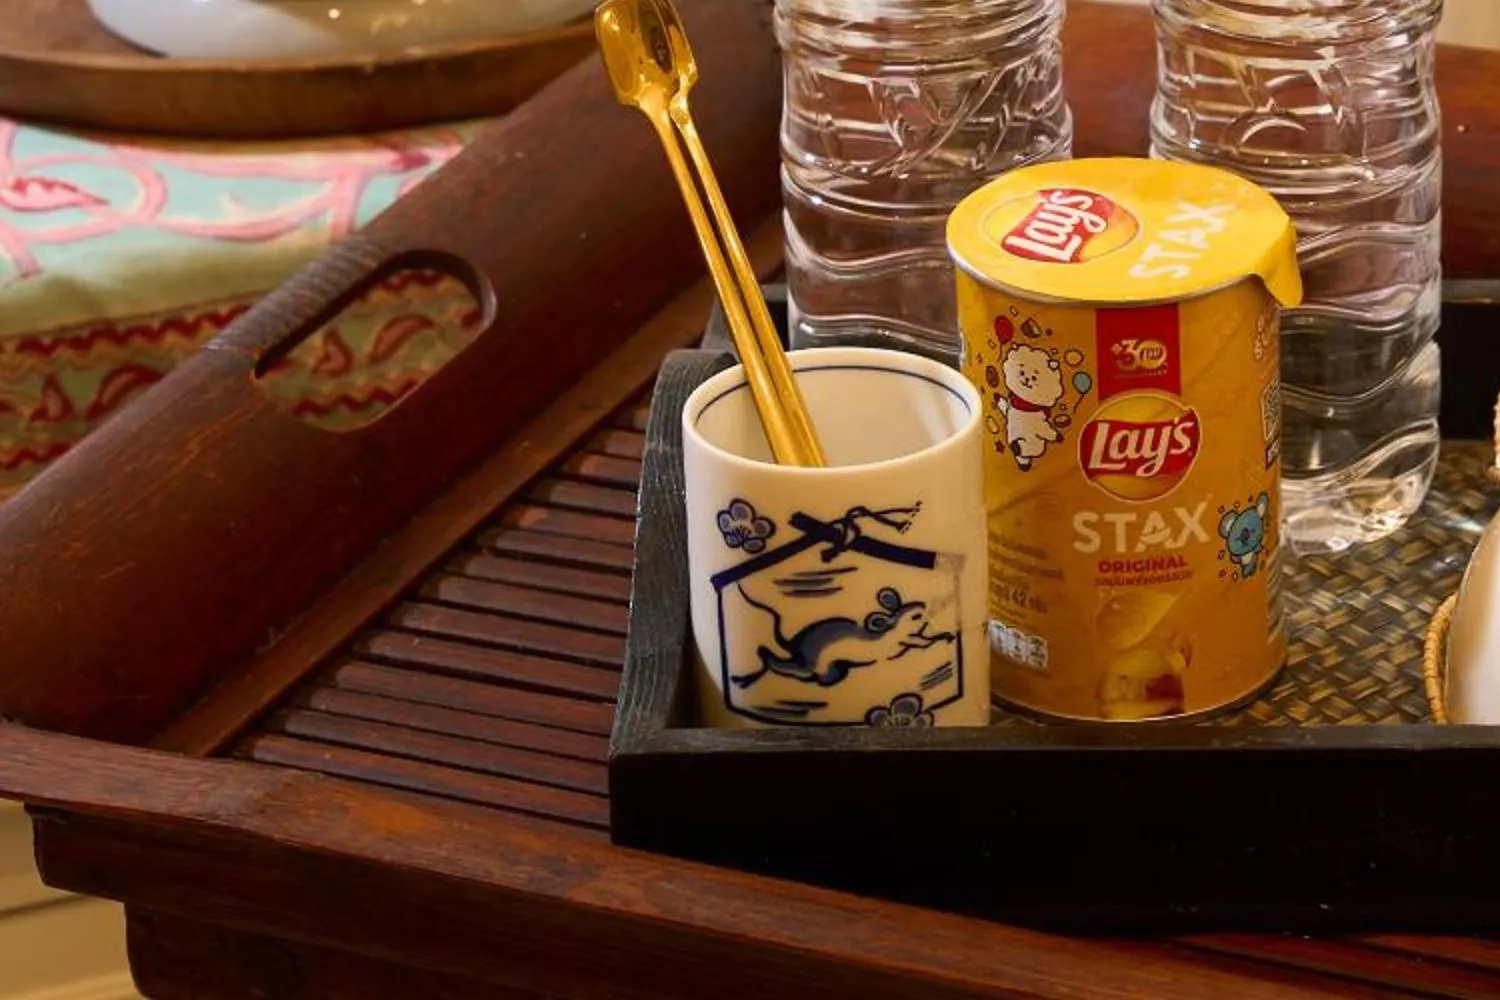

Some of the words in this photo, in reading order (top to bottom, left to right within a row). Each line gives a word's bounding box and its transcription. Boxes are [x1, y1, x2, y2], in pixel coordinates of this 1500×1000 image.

[1129, 200, 1237, 280] STAX
[1088, 418, 1195, 477] Lay's
[1072, 502, 1211, 553] STAX
[1097, 553, 1189, 574] ORIGINAL
